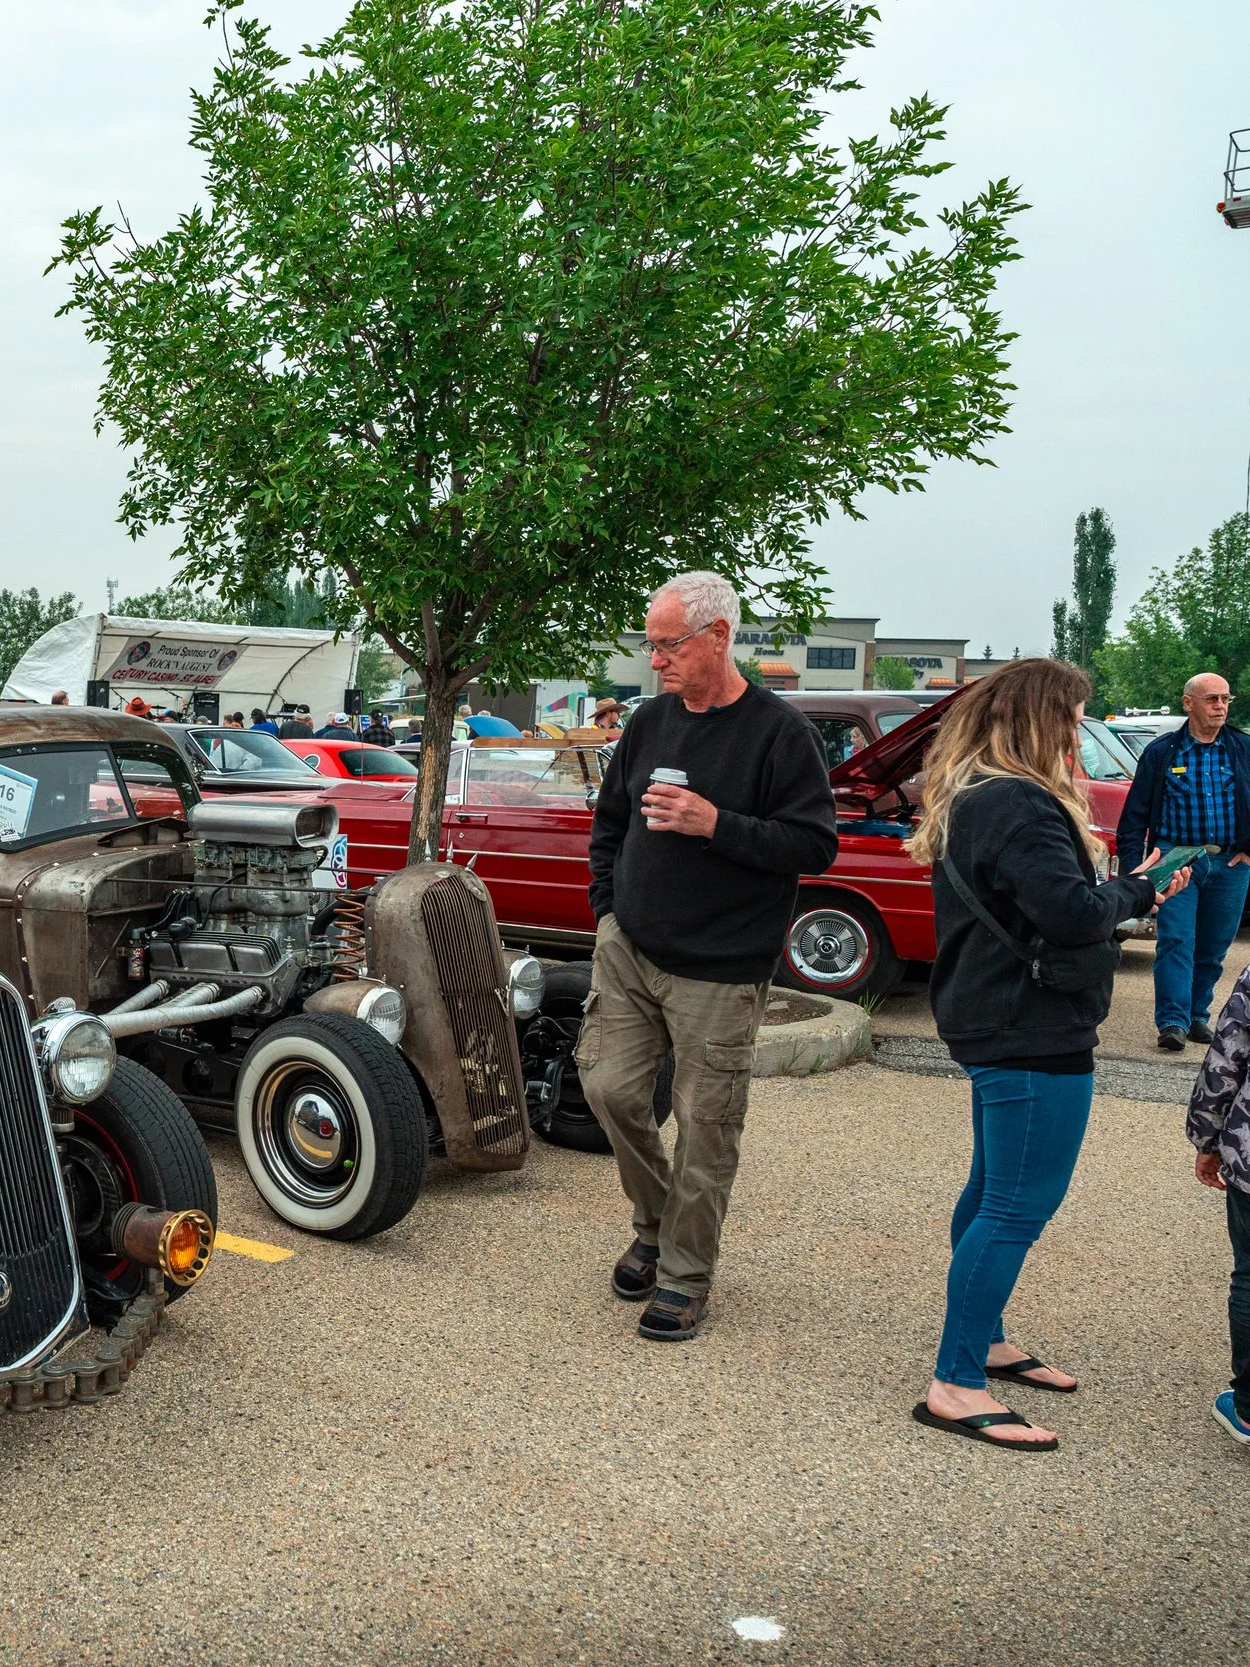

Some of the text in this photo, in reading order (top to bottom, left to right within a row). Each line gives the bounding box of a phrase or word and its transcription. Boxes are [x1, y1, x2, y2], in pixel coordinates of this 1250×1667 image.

[158, 644, 180, 656] Proud
[180, 646, 209, 658] Sponsor
[209, 648, 220, 659] Of
[147, 671, 178, 682] CASINO
